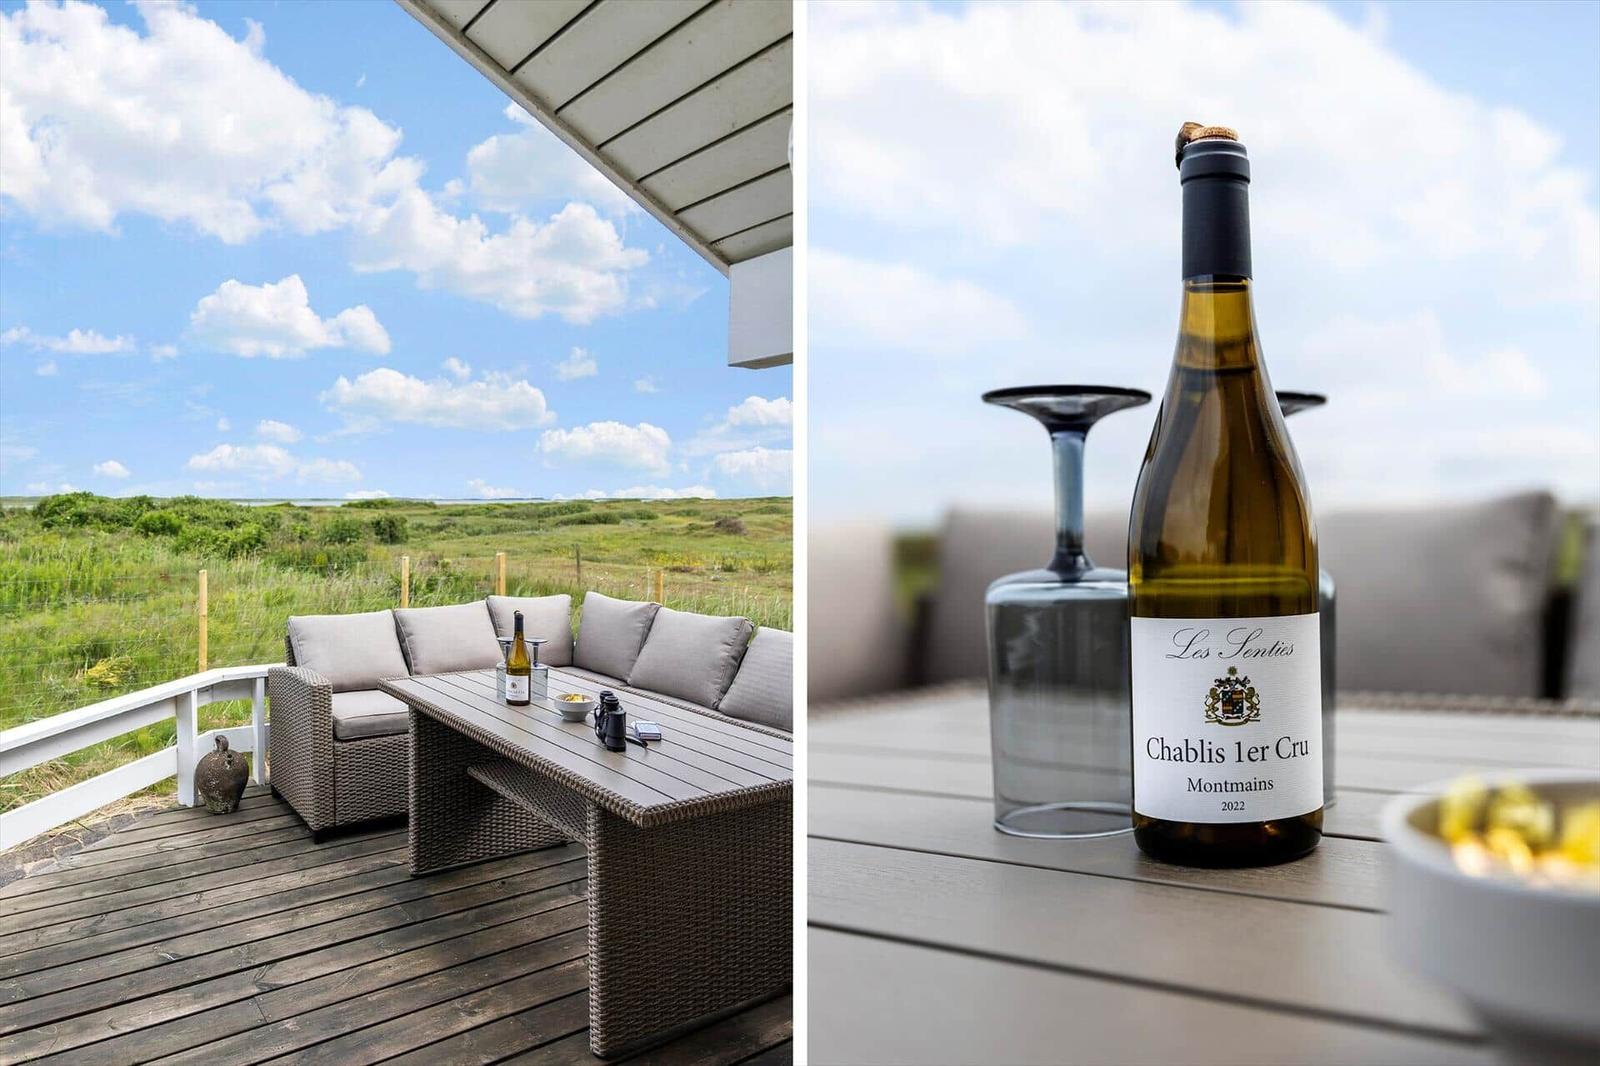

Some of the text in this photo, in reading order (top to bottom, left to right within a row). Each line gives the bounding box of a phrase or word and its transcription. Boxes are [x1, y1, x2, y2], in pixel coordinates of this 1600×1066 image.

[1166, 627, 1210, 659] Les
[1146, 736, 1309, 763] Chablis 1er Cru
[1187, 777, 1274, 793] Montmains
[1221, 801, 1245, 811] 2022
